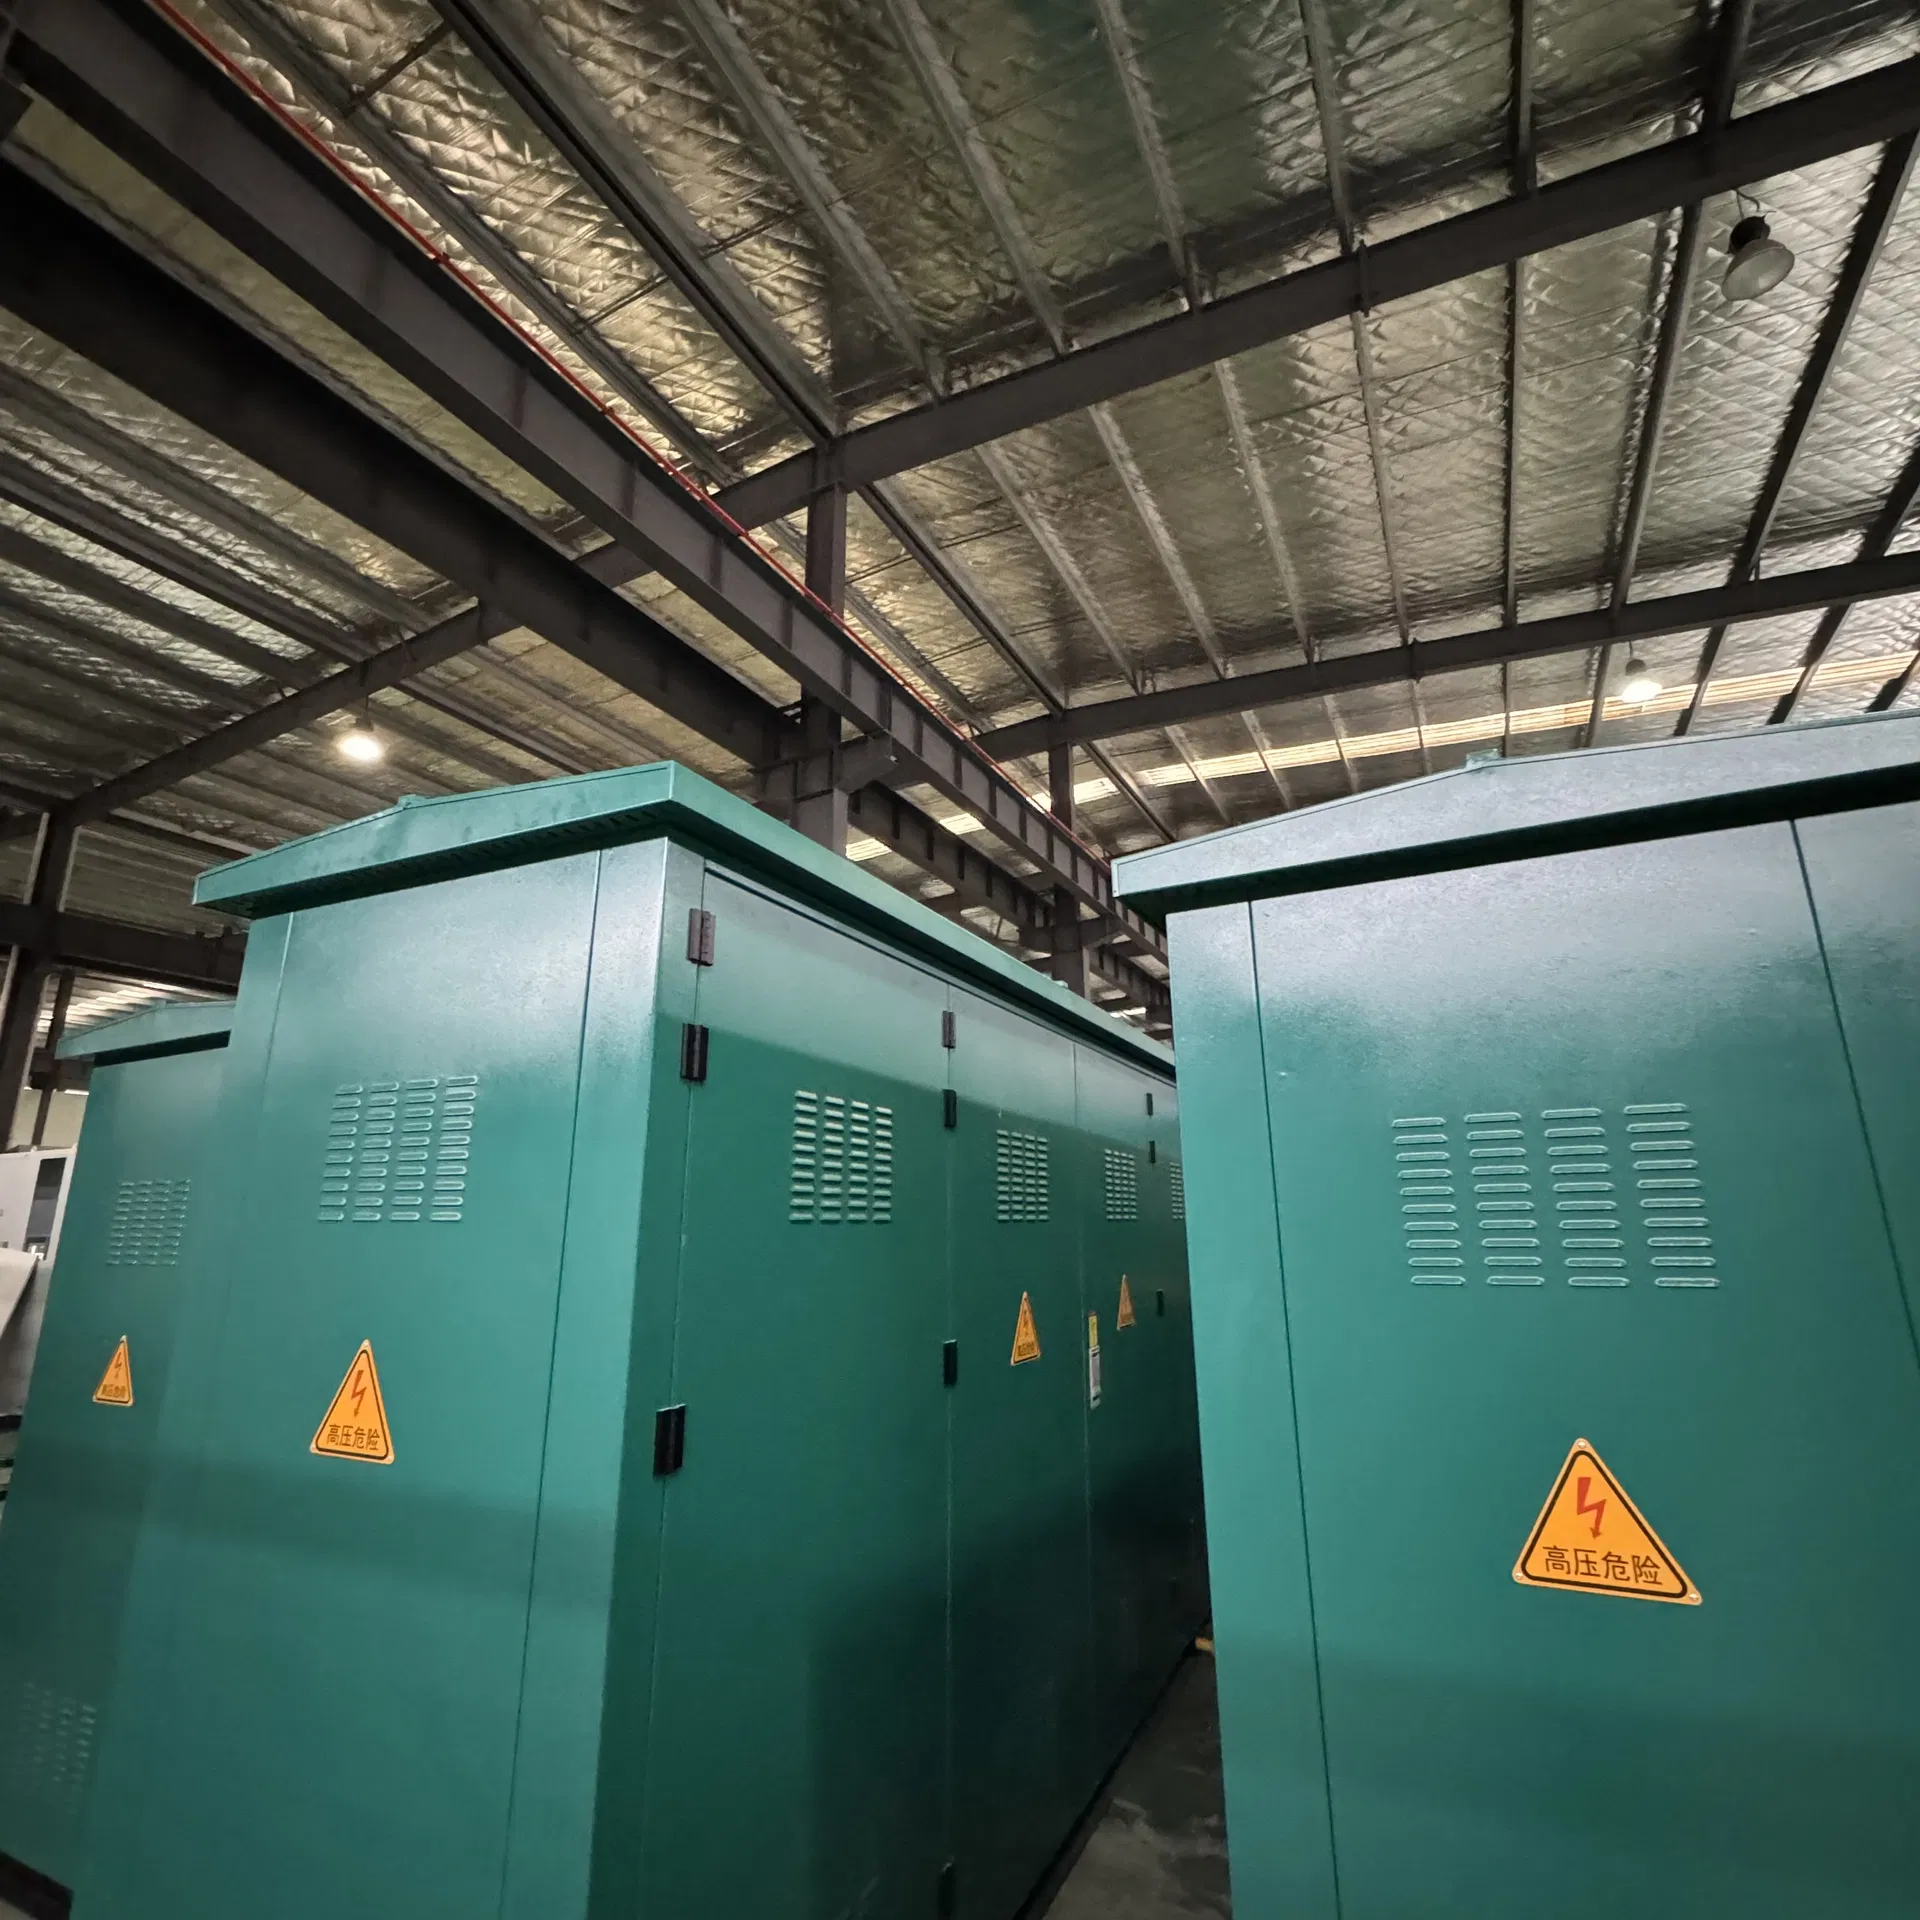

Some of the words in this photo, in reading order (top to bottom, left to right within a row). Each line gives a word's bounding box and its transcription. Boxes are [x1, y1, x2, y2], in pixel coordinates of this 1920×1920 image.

[327, 1424, 380, 1450] 高压危险
[1542, 1545, 1663, 1585] 高压危险
